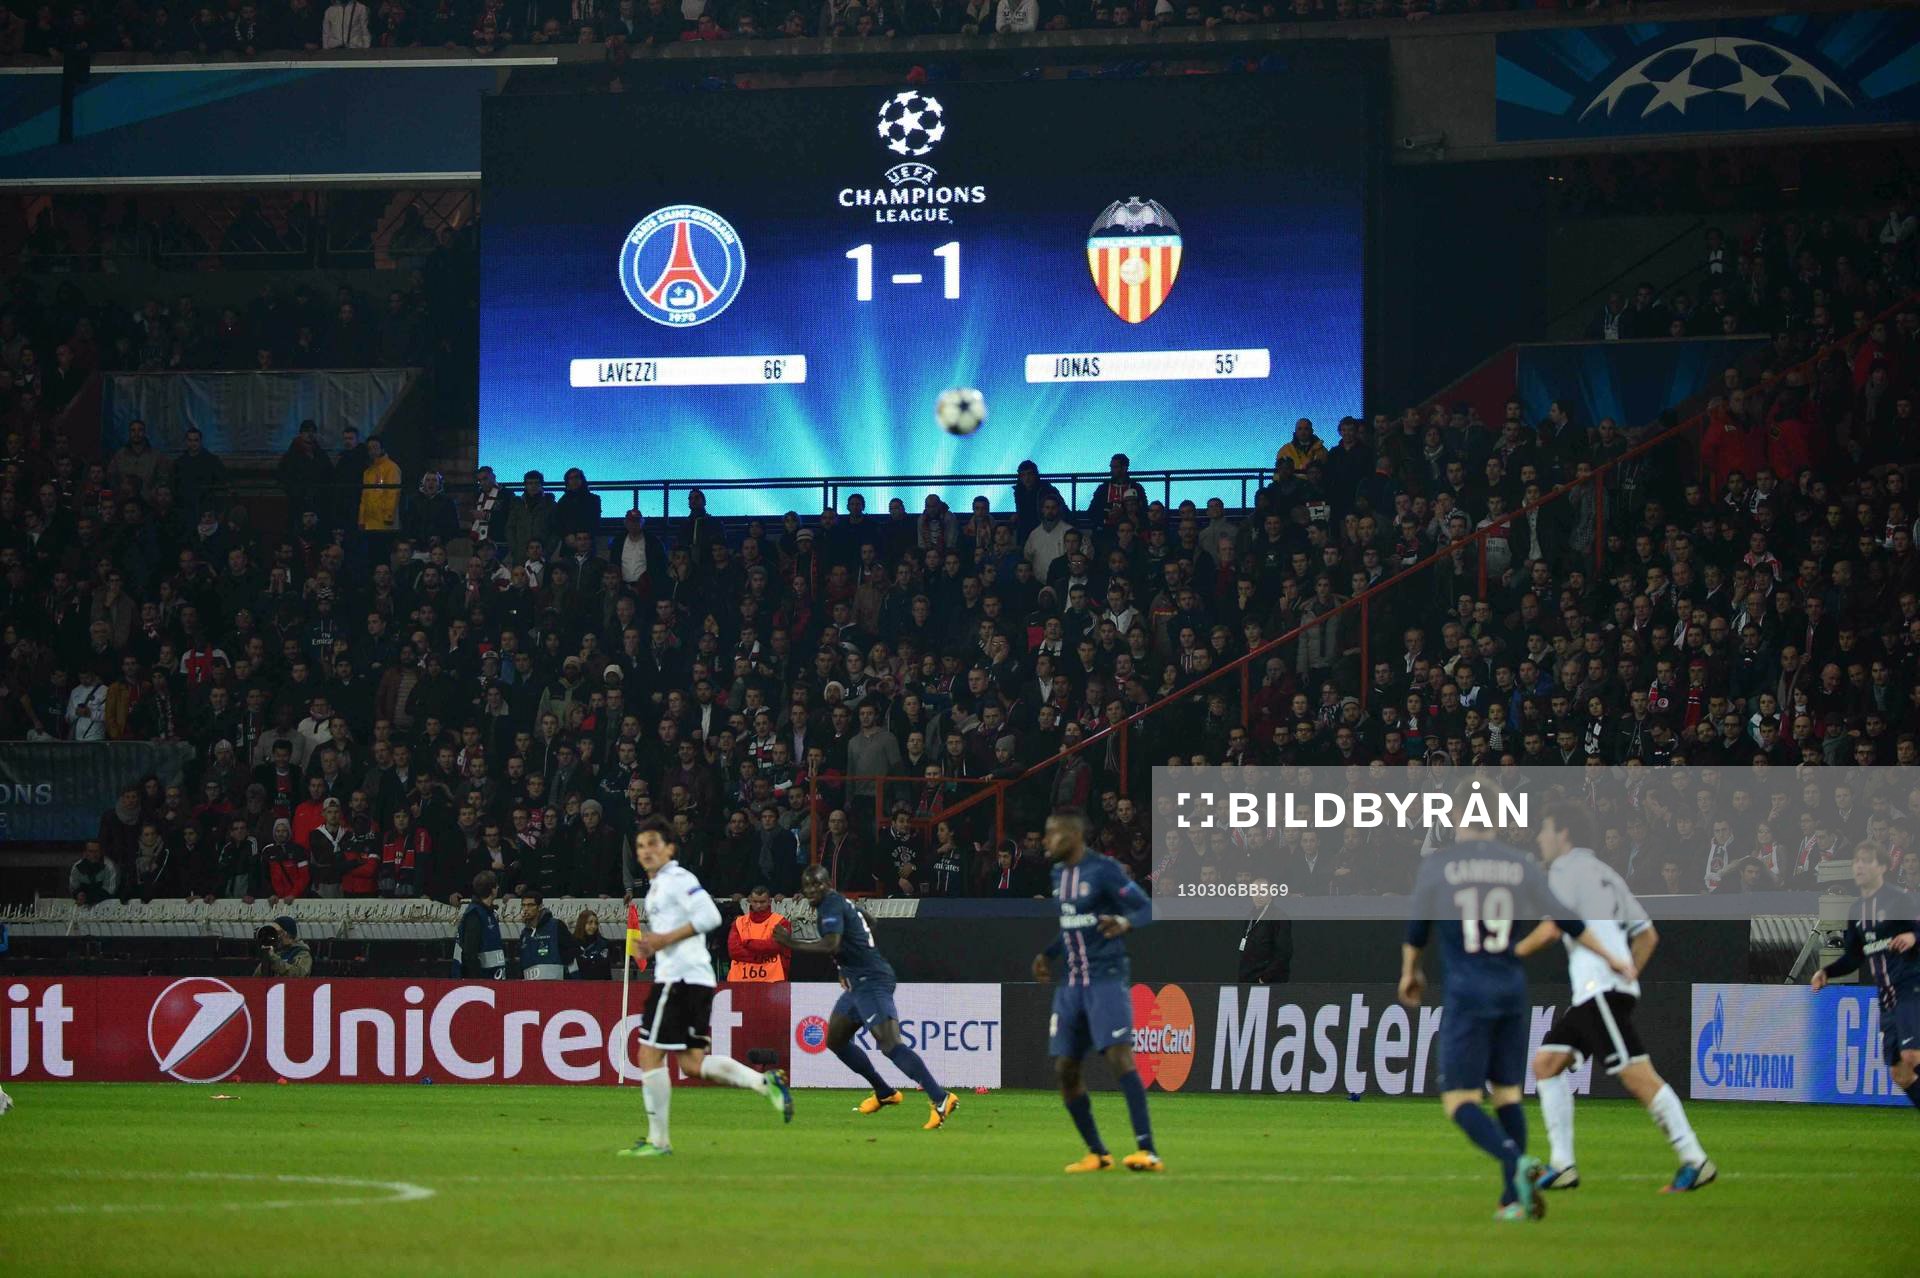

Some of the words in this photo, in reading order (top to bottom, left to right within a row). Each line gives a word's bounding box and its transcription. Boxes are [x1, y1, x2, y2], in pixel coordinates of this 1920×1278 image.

[886, 165, 935, 184] UEFA
[839, 186, 986, 207] CHAMPIONS
[876, 208, 949, 223] LEAGUE
[599, 362, 657, 382] LAVEZZI
[1053, 357, 1100, 378] JONAS
[1454, 887, 1514, 953] 19
[742, 966, 767, 980] 166
[266, 983, 743, 1082] UniCret
[856, 1020, 999, 1051] RSPECT
[1131, 1023, 1194, 1054] asterCard
[1725, 1053, 1794, 1089] GAZPROM
